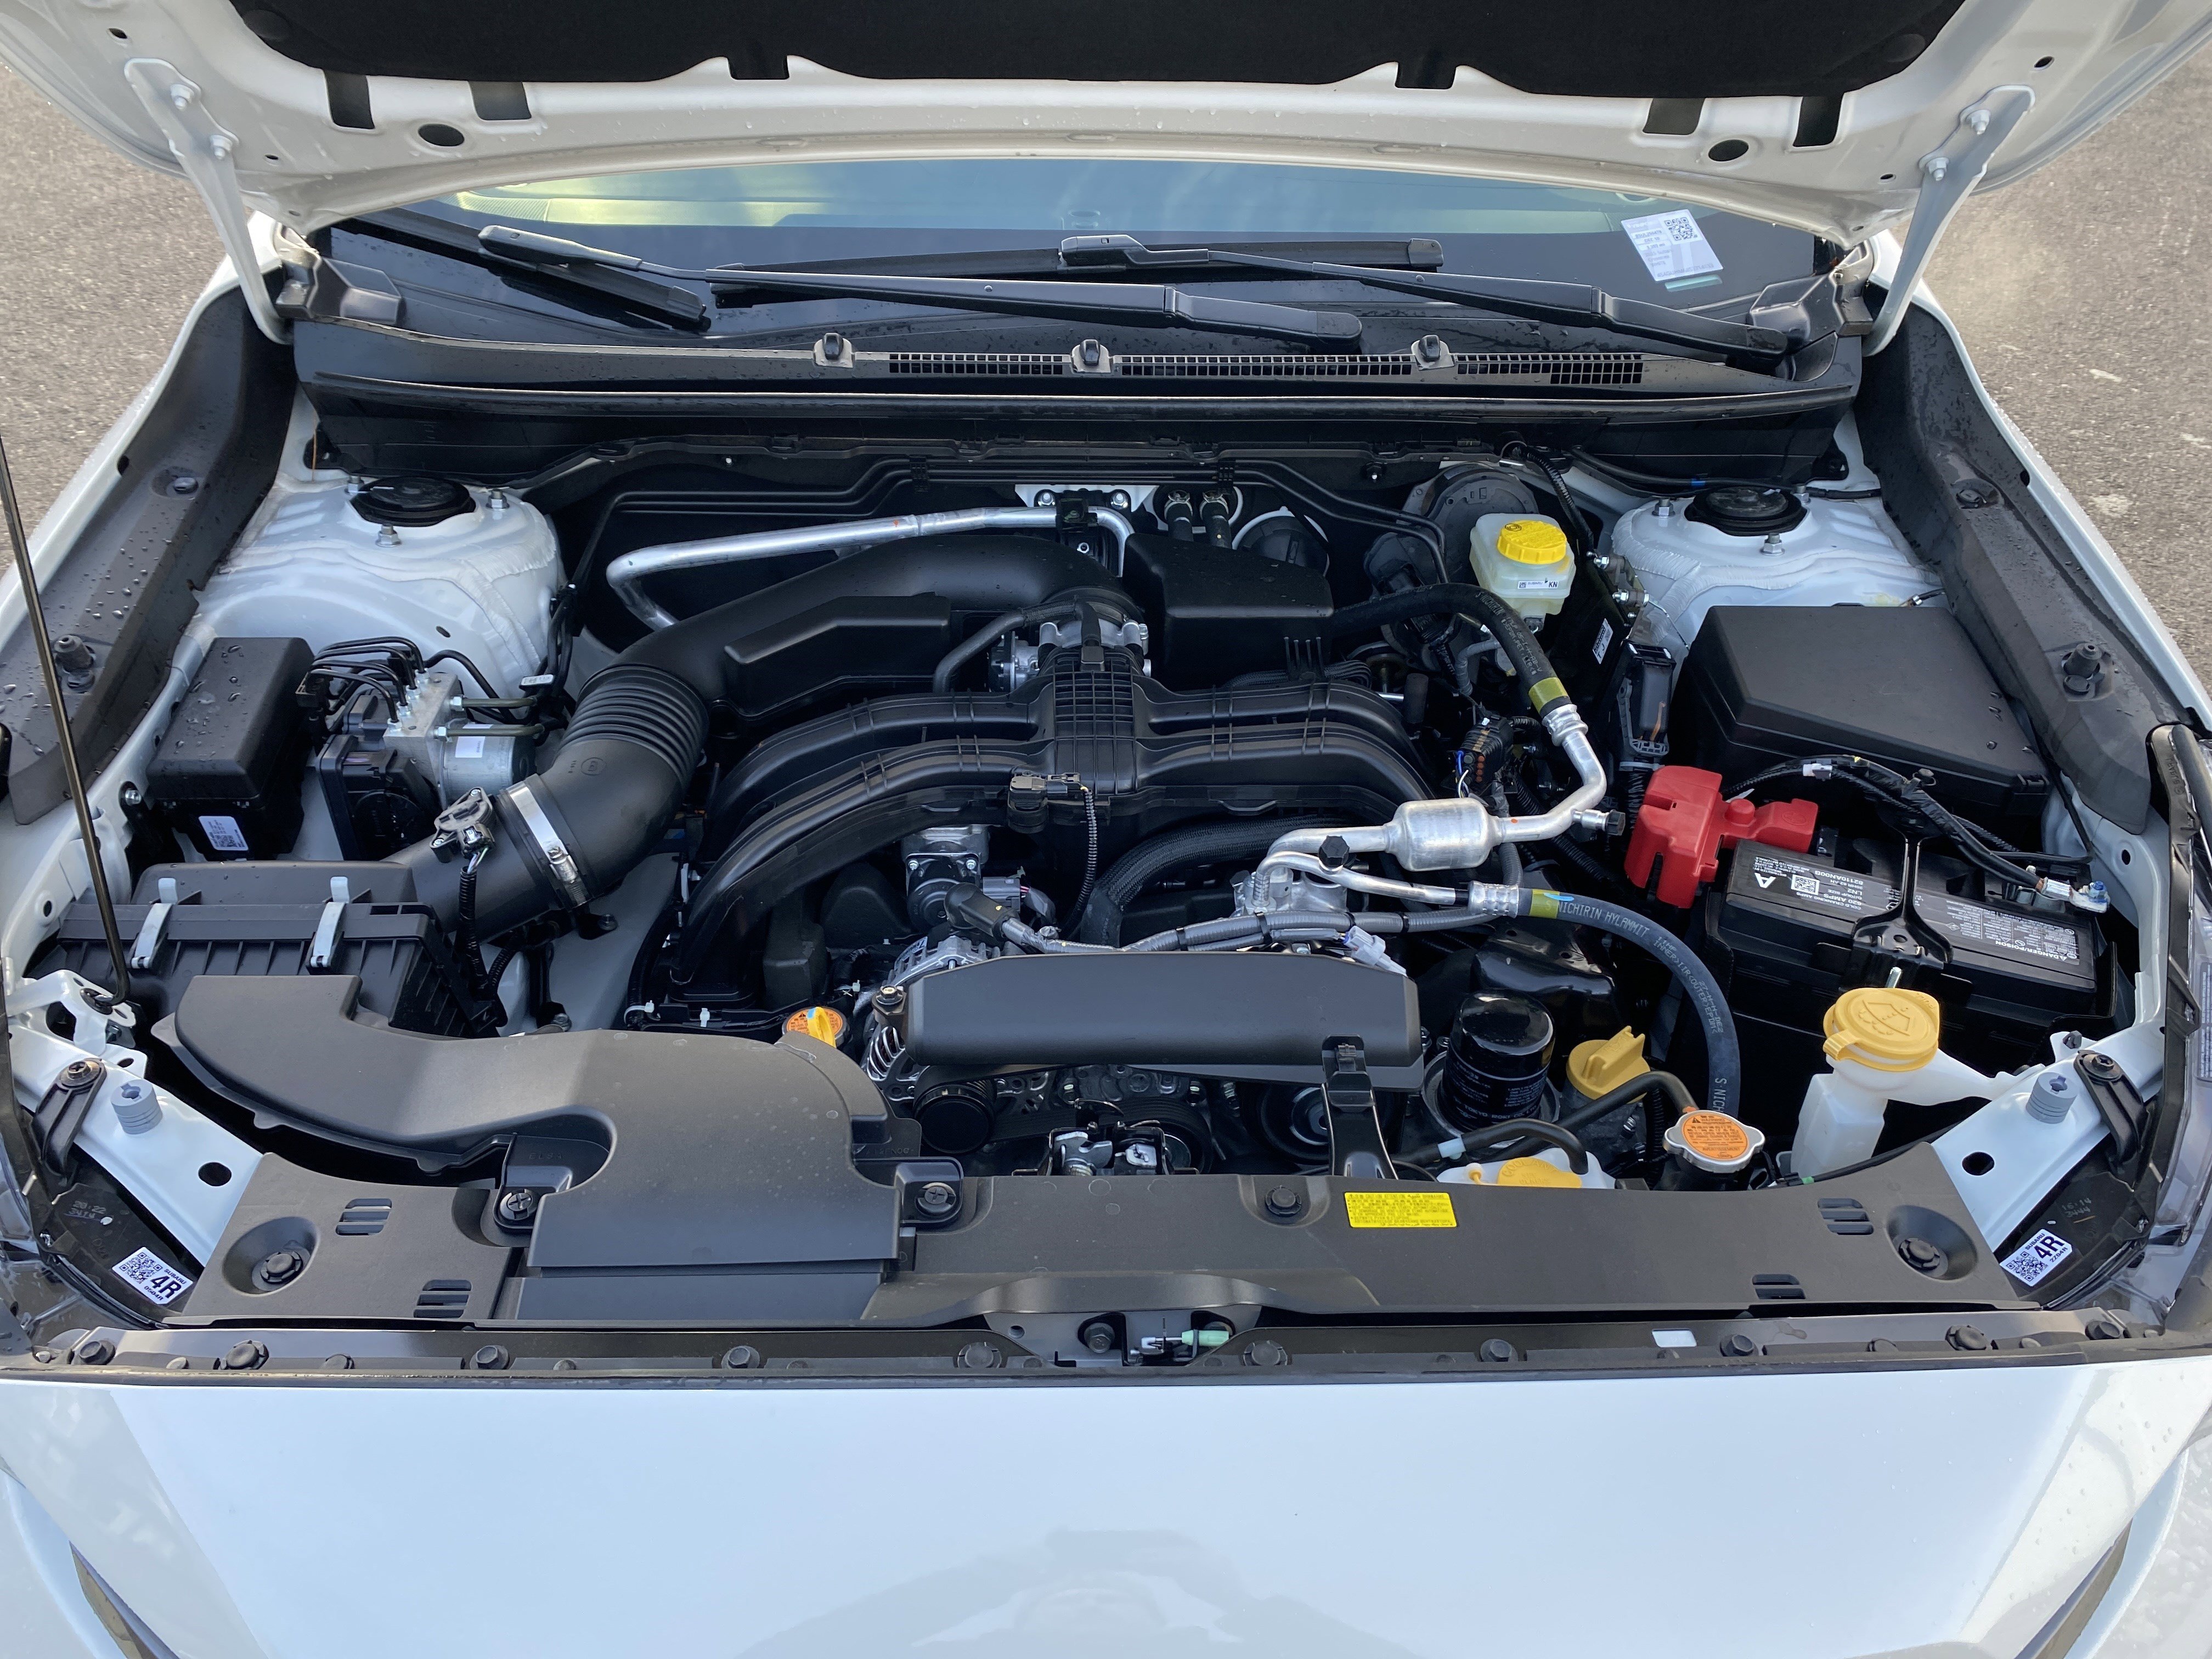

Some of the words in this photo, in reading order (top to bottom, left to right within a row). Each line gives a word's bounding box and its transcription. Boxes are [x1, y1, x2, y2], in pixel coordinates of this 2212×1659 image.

[1814, 896, 1844, 906] CRANKING
[1823, 893, 1847, 902] AMPS
[1995, 940, 2059, 960] DANGER/POISON
[1465, 1104, 1488, 1117] TOKYO
[2025, 1233, 2045, 1250] SUBARU
[2034, 1235, 2065, 1259] 4R
[164, 1268, 187, 1284] SUBARU
[150, 1276, 182, 1299] 4R
